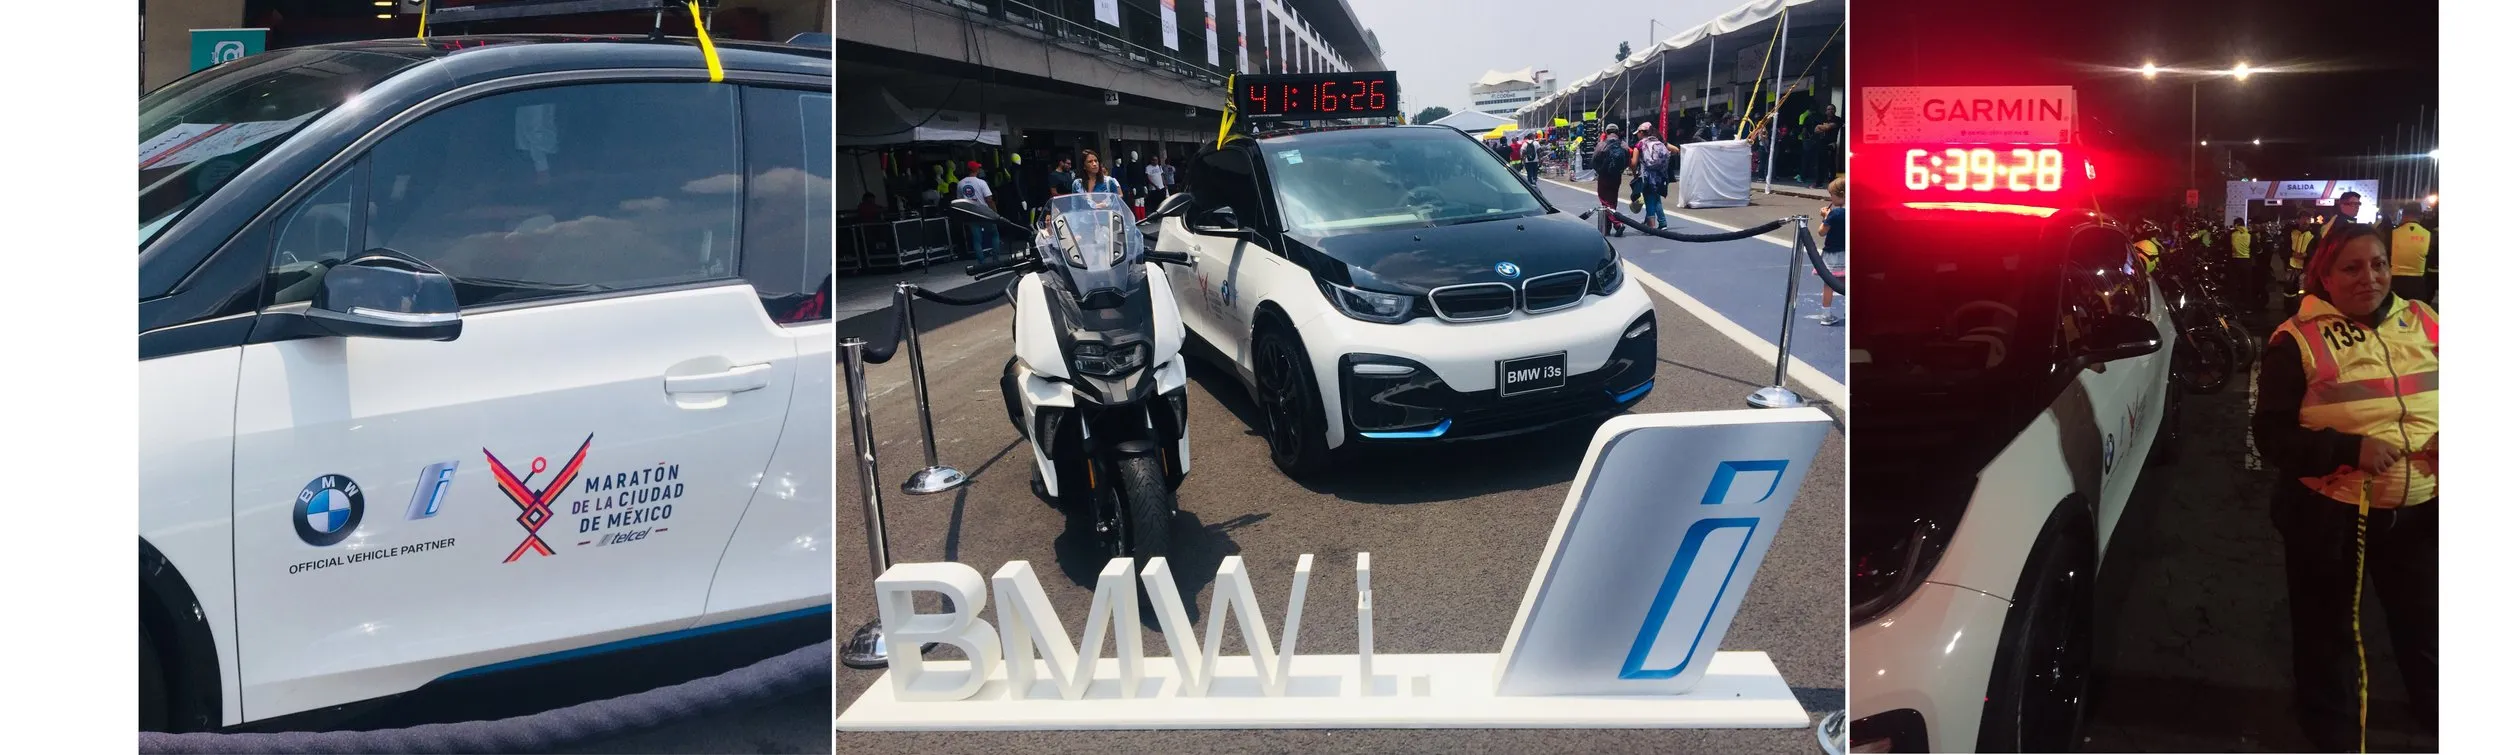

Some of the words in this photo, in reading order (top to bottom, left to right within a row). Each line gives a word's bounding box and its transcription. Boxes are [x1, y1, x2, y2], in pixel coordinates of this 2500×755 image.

[1106, 93, 1118, 101] 21
[1923, 98, 2062, 122] GARMIN
[2323, 320, 2366, 351] 135
[1507, 368, 1541, 384] BMW
[1543, 365, 1562, 379] i3s
[300, 476, 359, 503] BMW
[585, 461, 680, 494] MARATÓN
[571, 500, 590, 515] DE
[595, 496, 613, 511] LA
[618, 483, 684, 507] CIUDAD
[579, 516, 601, 533] DE
[607, 504, 673, 529] MÉXICO
[611, 527, 653, 545] telcel
[288, 555, 345, 575] OFFICIAL
[346, 548, 398, 564] VEHICLE
[400, 538, 456, 555] PARTNER
[875, 554, 1315, 702] BMW
